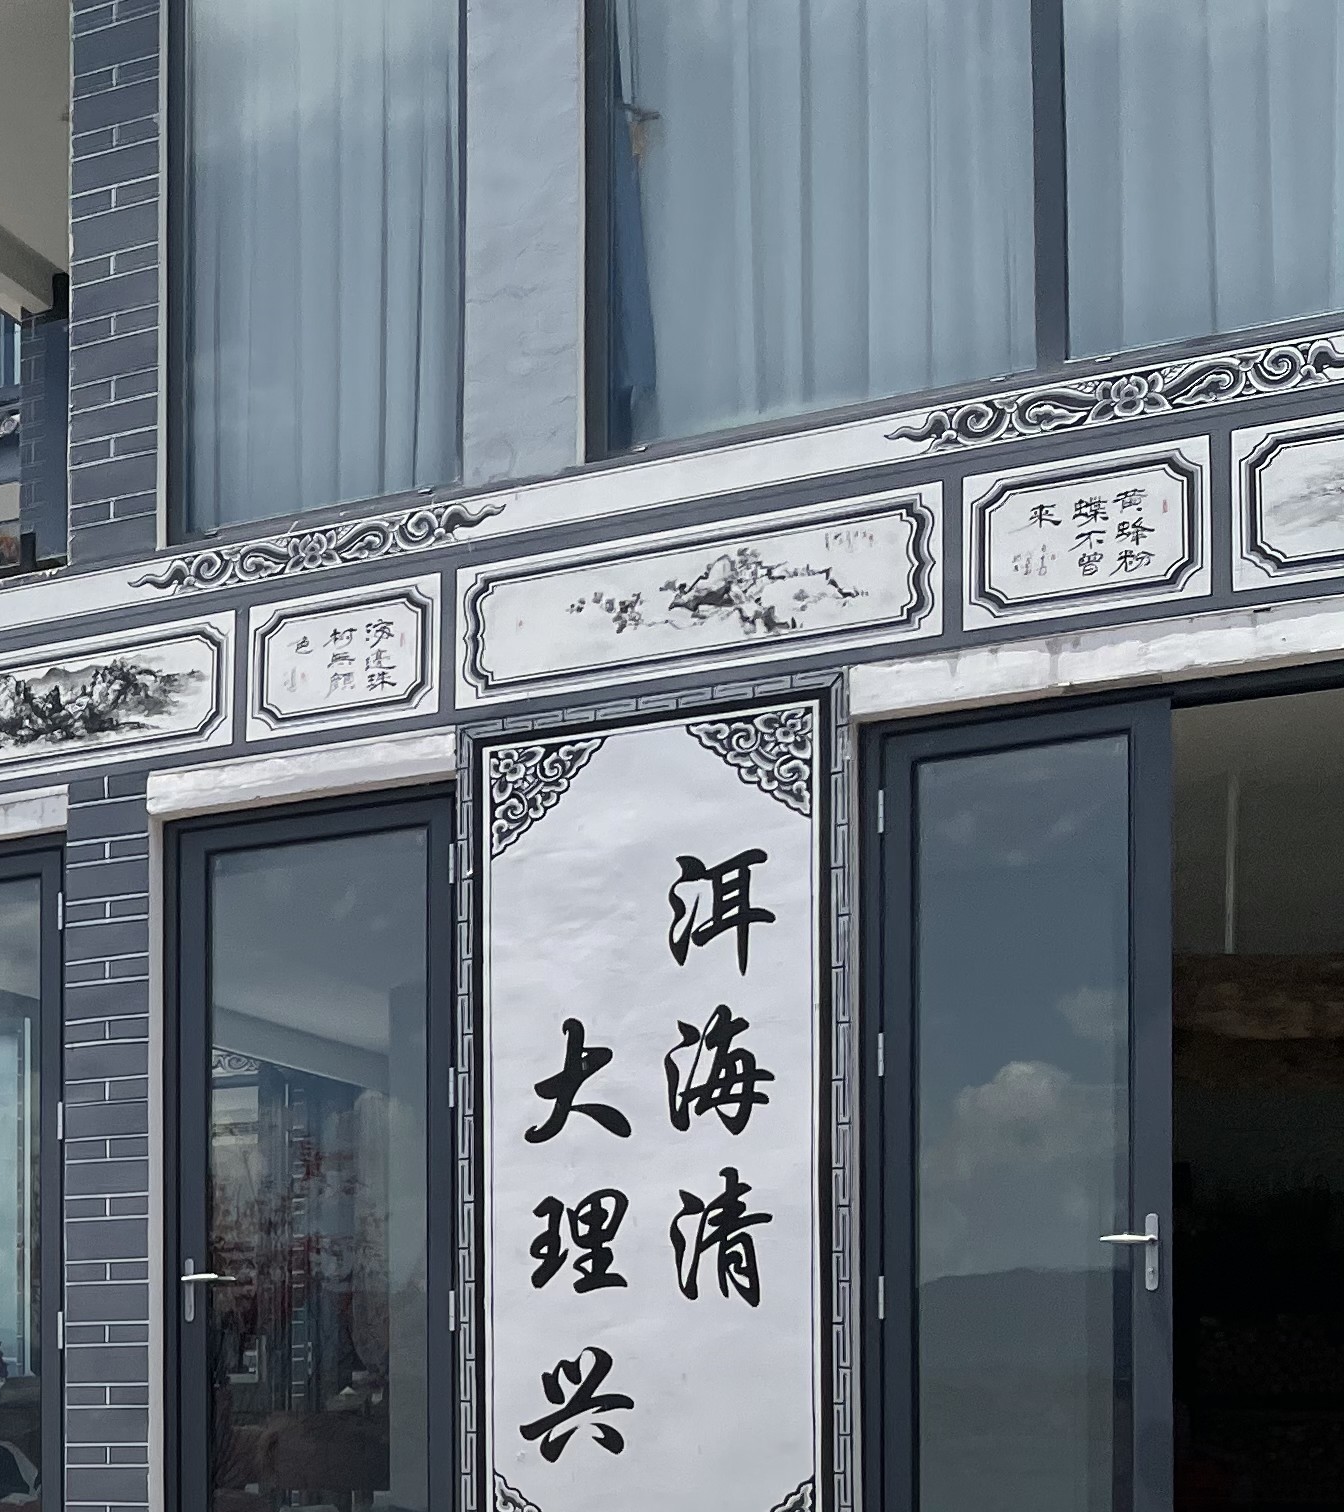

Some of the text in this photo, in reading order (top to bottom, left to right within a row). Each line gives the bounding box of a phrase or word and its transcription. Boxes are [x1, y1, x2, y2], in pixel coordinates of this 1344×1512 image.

[519, 1018, 634, 1464] 大理兴
[664, 848, 776, 1308] 洱海清
